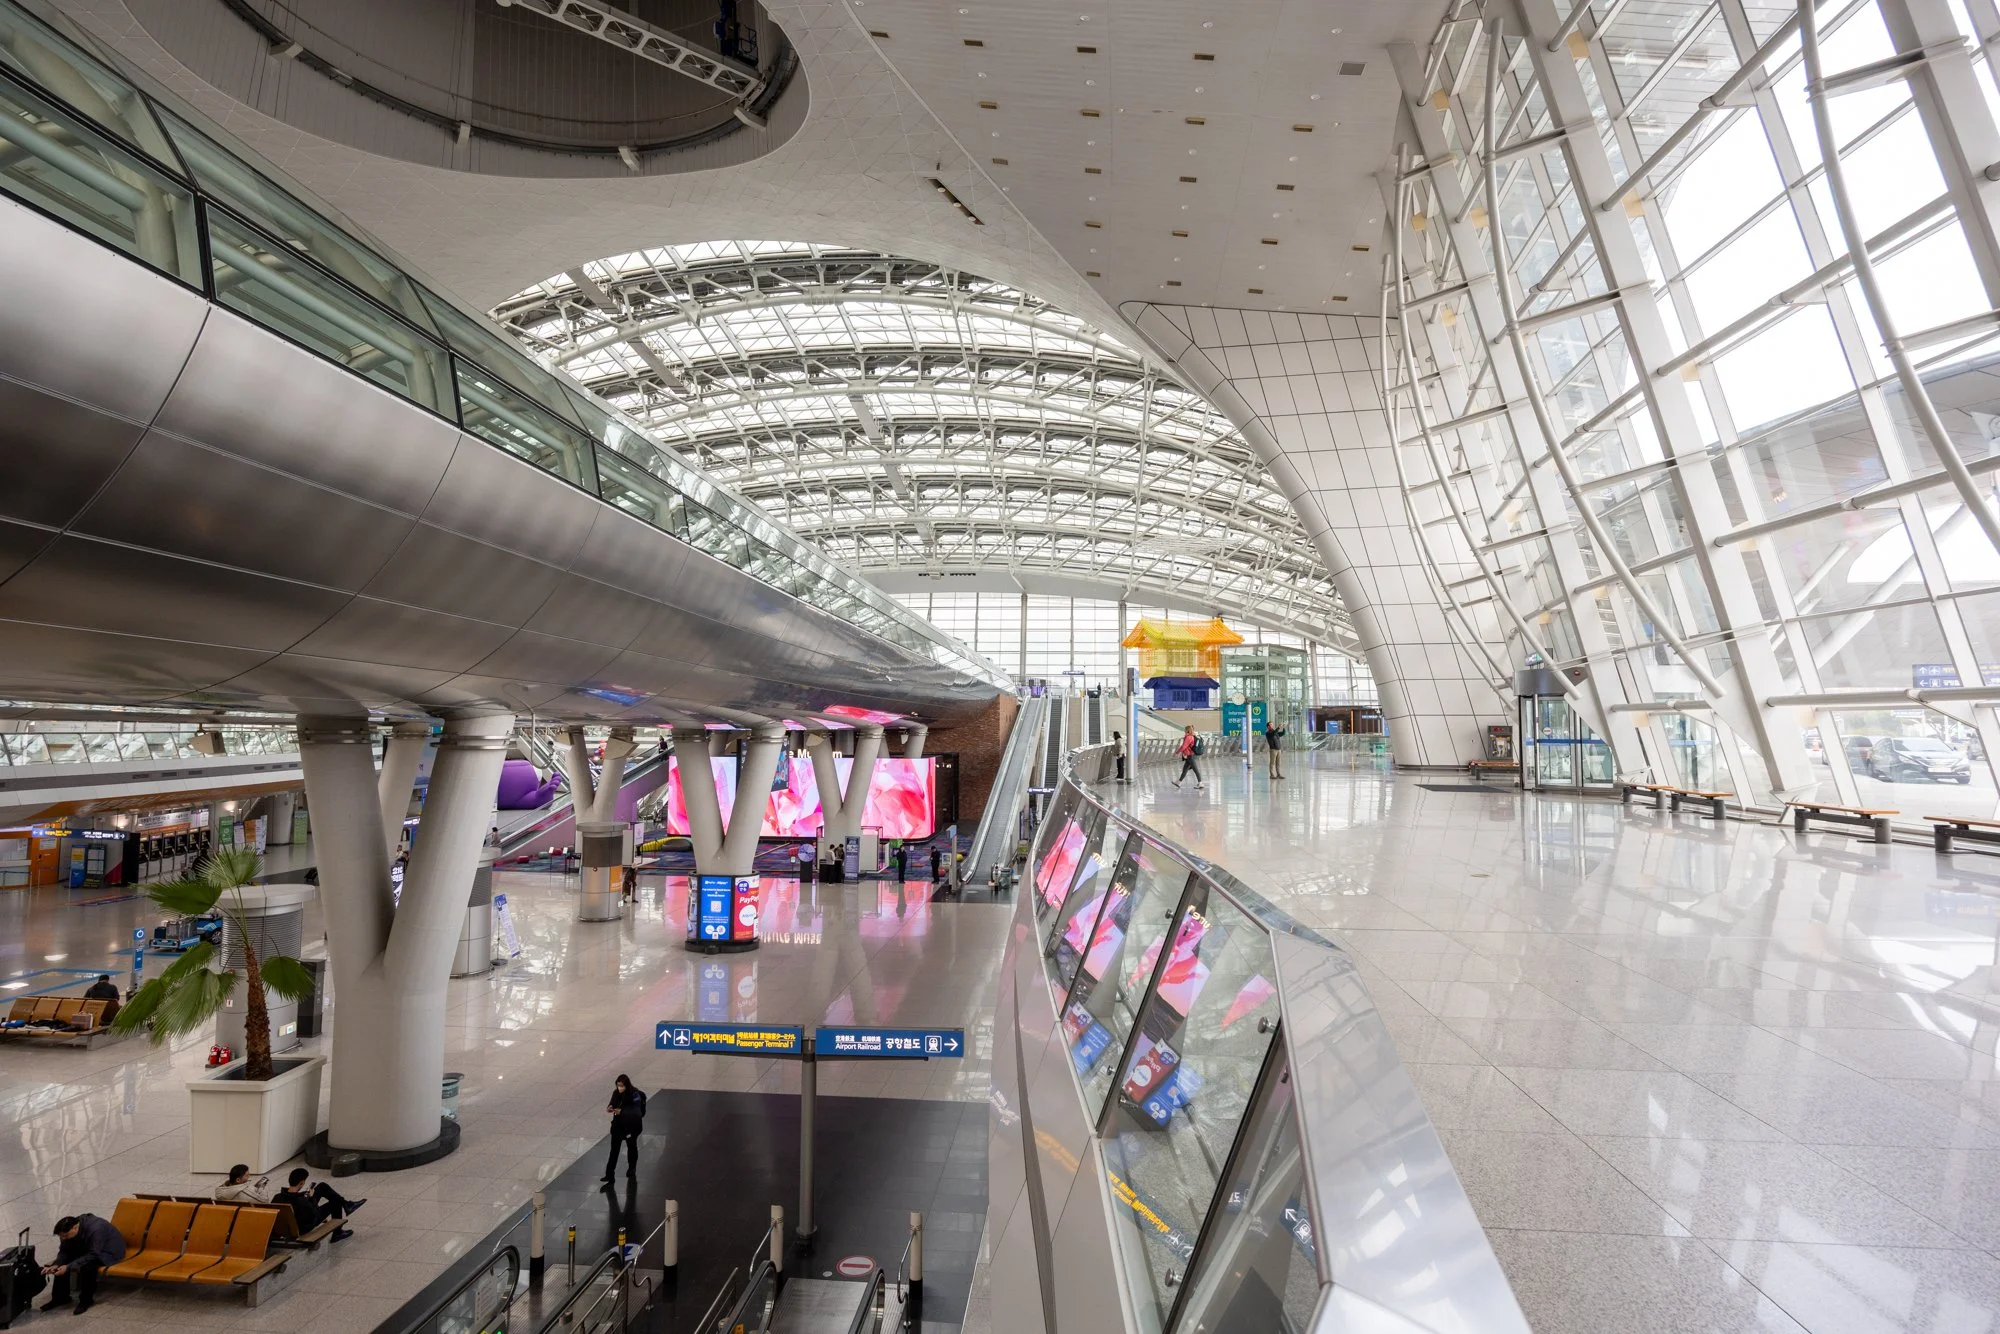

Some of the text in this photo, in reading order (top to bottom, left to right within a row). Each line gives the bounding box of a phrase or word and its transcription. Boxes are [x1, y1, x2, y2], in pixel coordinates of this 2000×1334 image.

[736, 1039, 765, 1049] Passenger
[765, 1040, 789, 1048] Terminal
[885, 1038, 921, 1049] 공항철도
